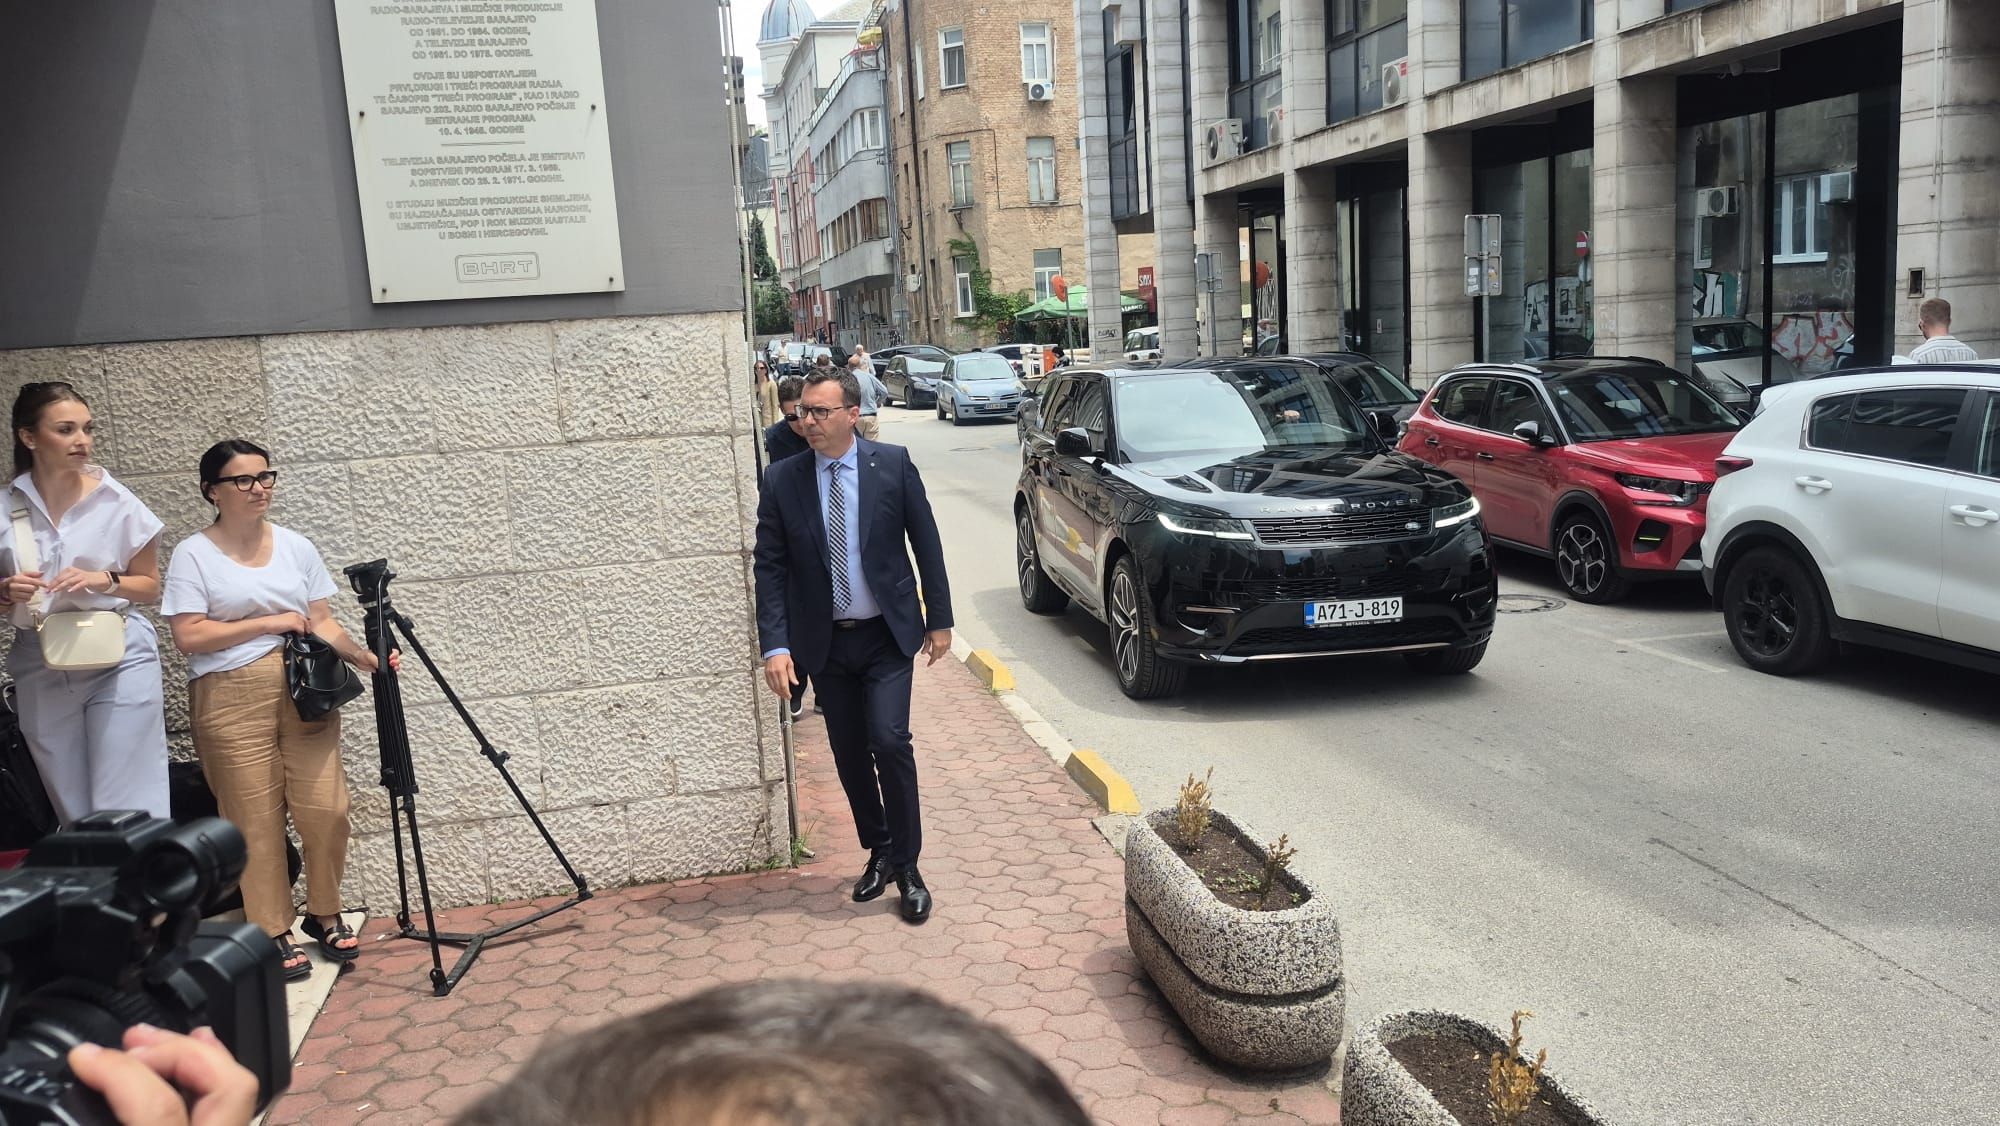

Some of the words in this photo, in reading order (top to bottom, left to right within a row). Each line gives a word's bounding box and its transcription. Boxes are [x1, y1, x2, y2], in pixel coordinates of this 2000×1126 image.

[487, 15, 536, 24] SARAJEVO
[410, 28, 423, 36] OD
[451, 28, 465, 36] DO
[415, 40, 423, 48] A
[478, 38, 527, 46] SARAJEVO
[454, 50, 467, 58] DO
[413, 72, 444, 80] OVDJE
[447, 71, 459, 79] SU
[480, 81, 526, 90] PROGRAM
[524, 91, 544, 100] KAO
[551, 90, 579, 99] RADIO
[380, 106, 431, 114] SARAJEVO
[454, 105, 483, 113] RADIO
[485, 103, 534, 112] SARAJEVO
[482, 114, 536, 123] PROGRAMA
[436, 155, 486, 164] SARAJEVO
[528, 153, 539, 161] JE
[465, 165, 512, 175] PROGRAM
[460, 220, 480, 228] POP
[463, 260, 533, 275] BHRT
[1351, 498, 1419, 510] ROVER
[1318, 600, 1400, 620] A71-J-819
